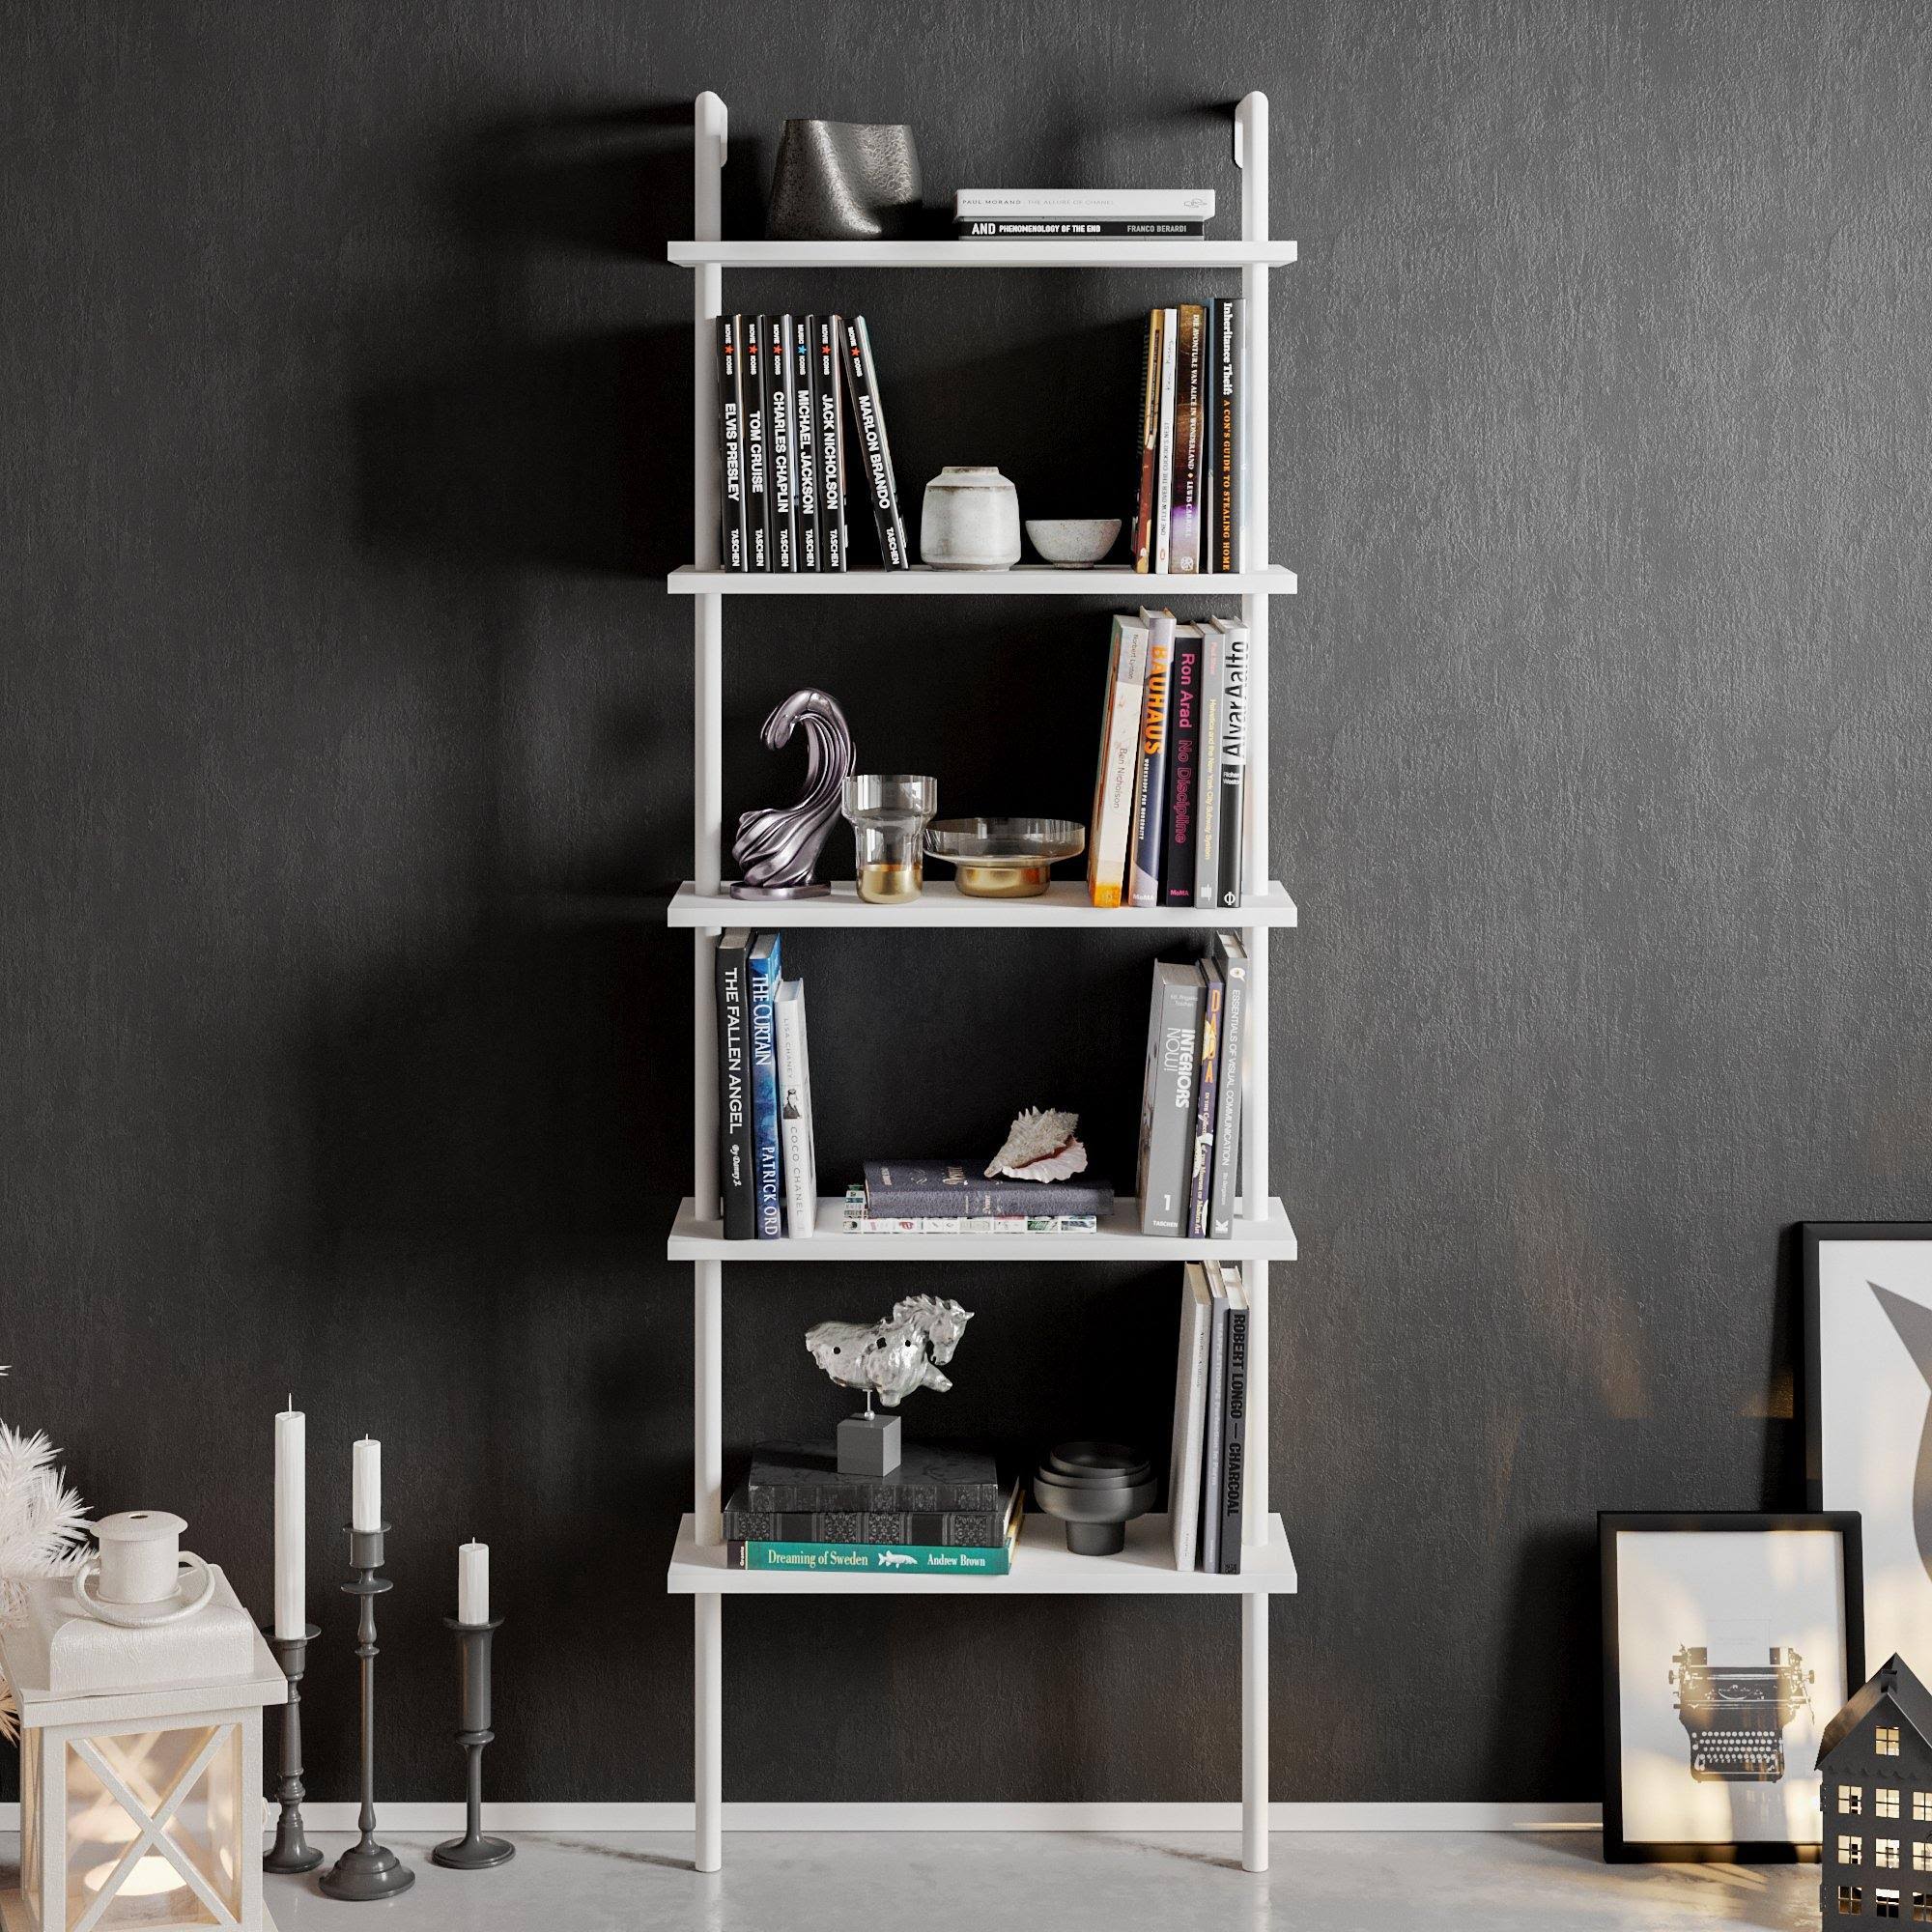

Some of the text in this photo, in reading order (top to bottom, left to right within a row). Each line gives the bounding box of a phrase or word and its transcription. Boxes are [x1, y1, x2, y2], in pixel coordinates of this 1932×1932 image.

[972, 222, 995, 235] AND
[1223, 302, 1233, 362] Inheritance
[725, 403, 736, 440] ELVIS
[750, 412, 761, 440] TOM
[774, 391, 785, 452] CHARLES
[799, 390, 810, 448] MICHAEL
[822, 394, 834, 430] JACK
[1189, 407, 1197, 416] IN
[848, 327, 899, 565] MOVIE ICONS MARLON BRANDO TASCHEN
[1187, 417, 1197, 469] WONDERLAND
[726, 442, 739, 500] PRESLEY
[751, 444, 763, 493] CRUISE
[776, 454, 788, 513] CHAPLIN
[800, 451, 813, 514] JACKSON
[824, 433, 838, 509] NICHOLSON
[1223, 475, 1230, 487] TO
[1185, 481, 1194, 502] LEWIS
[730, 529, 740, 567] TASCHEN
[754, 528, 764, 567] TASCHEN
[780, 529, 789, 567] TASCHEN
[805, 529, 814, 567] TASCHEN
[829, 529, 838, 567] TASCHEN
[1130, 634, 1139, 657] Norbert
[1145, 645, 1169, 754] BAUHAUS
[1223, 640, 1248, 757] Alvar Aalto
[1118, 748, 1128, 765] Ben
[1174, 653, 1194, 843] Ron Arad No Discipline
[1113, 767, 1125, 809] Nicholson
[1205, 806, 1213, 833] Subway
[753, 974, 772, 1065] THE CURTAIN
[1230, 989, 1240, 1042] ESSENTIALS
[724, 968, 742, 1133] THE FALLEN ANGEL
[1164, 1028, 1180, 1072] NOW!
[1175, 1029, 1195, 1108] INTERIORS
[1229, 1043, 1238, 1056] OF
[1227, 1058, 1237, 1088] VISUAL
[731, 1145, 740, 1155] By
[1222, 1091, 1236, 1166] COMMUNICATION
[731, 1156, 741, 1179] Danny
[791, 1126, 803, 1216] COCO CHANEL
[762, 1147, 778, 1236] PATRICK ORD
[1164, 1194, 1171, 1211] 1
[1213, 1322, 1224, 1399] MAPPLETHORPE
[1232, 1315, 1245, 1369] ROBERT
[1231, 1374, 1243, 1419] LONGO
[1212, 1401, 1221, 1448] Perfection
[1227, 1443, 1241, 1517] CHARCOAL
[768, 1549, 867, 1567] Dreaming of Sweden
[927, 1554, 985, 1567] Andrew Brown
